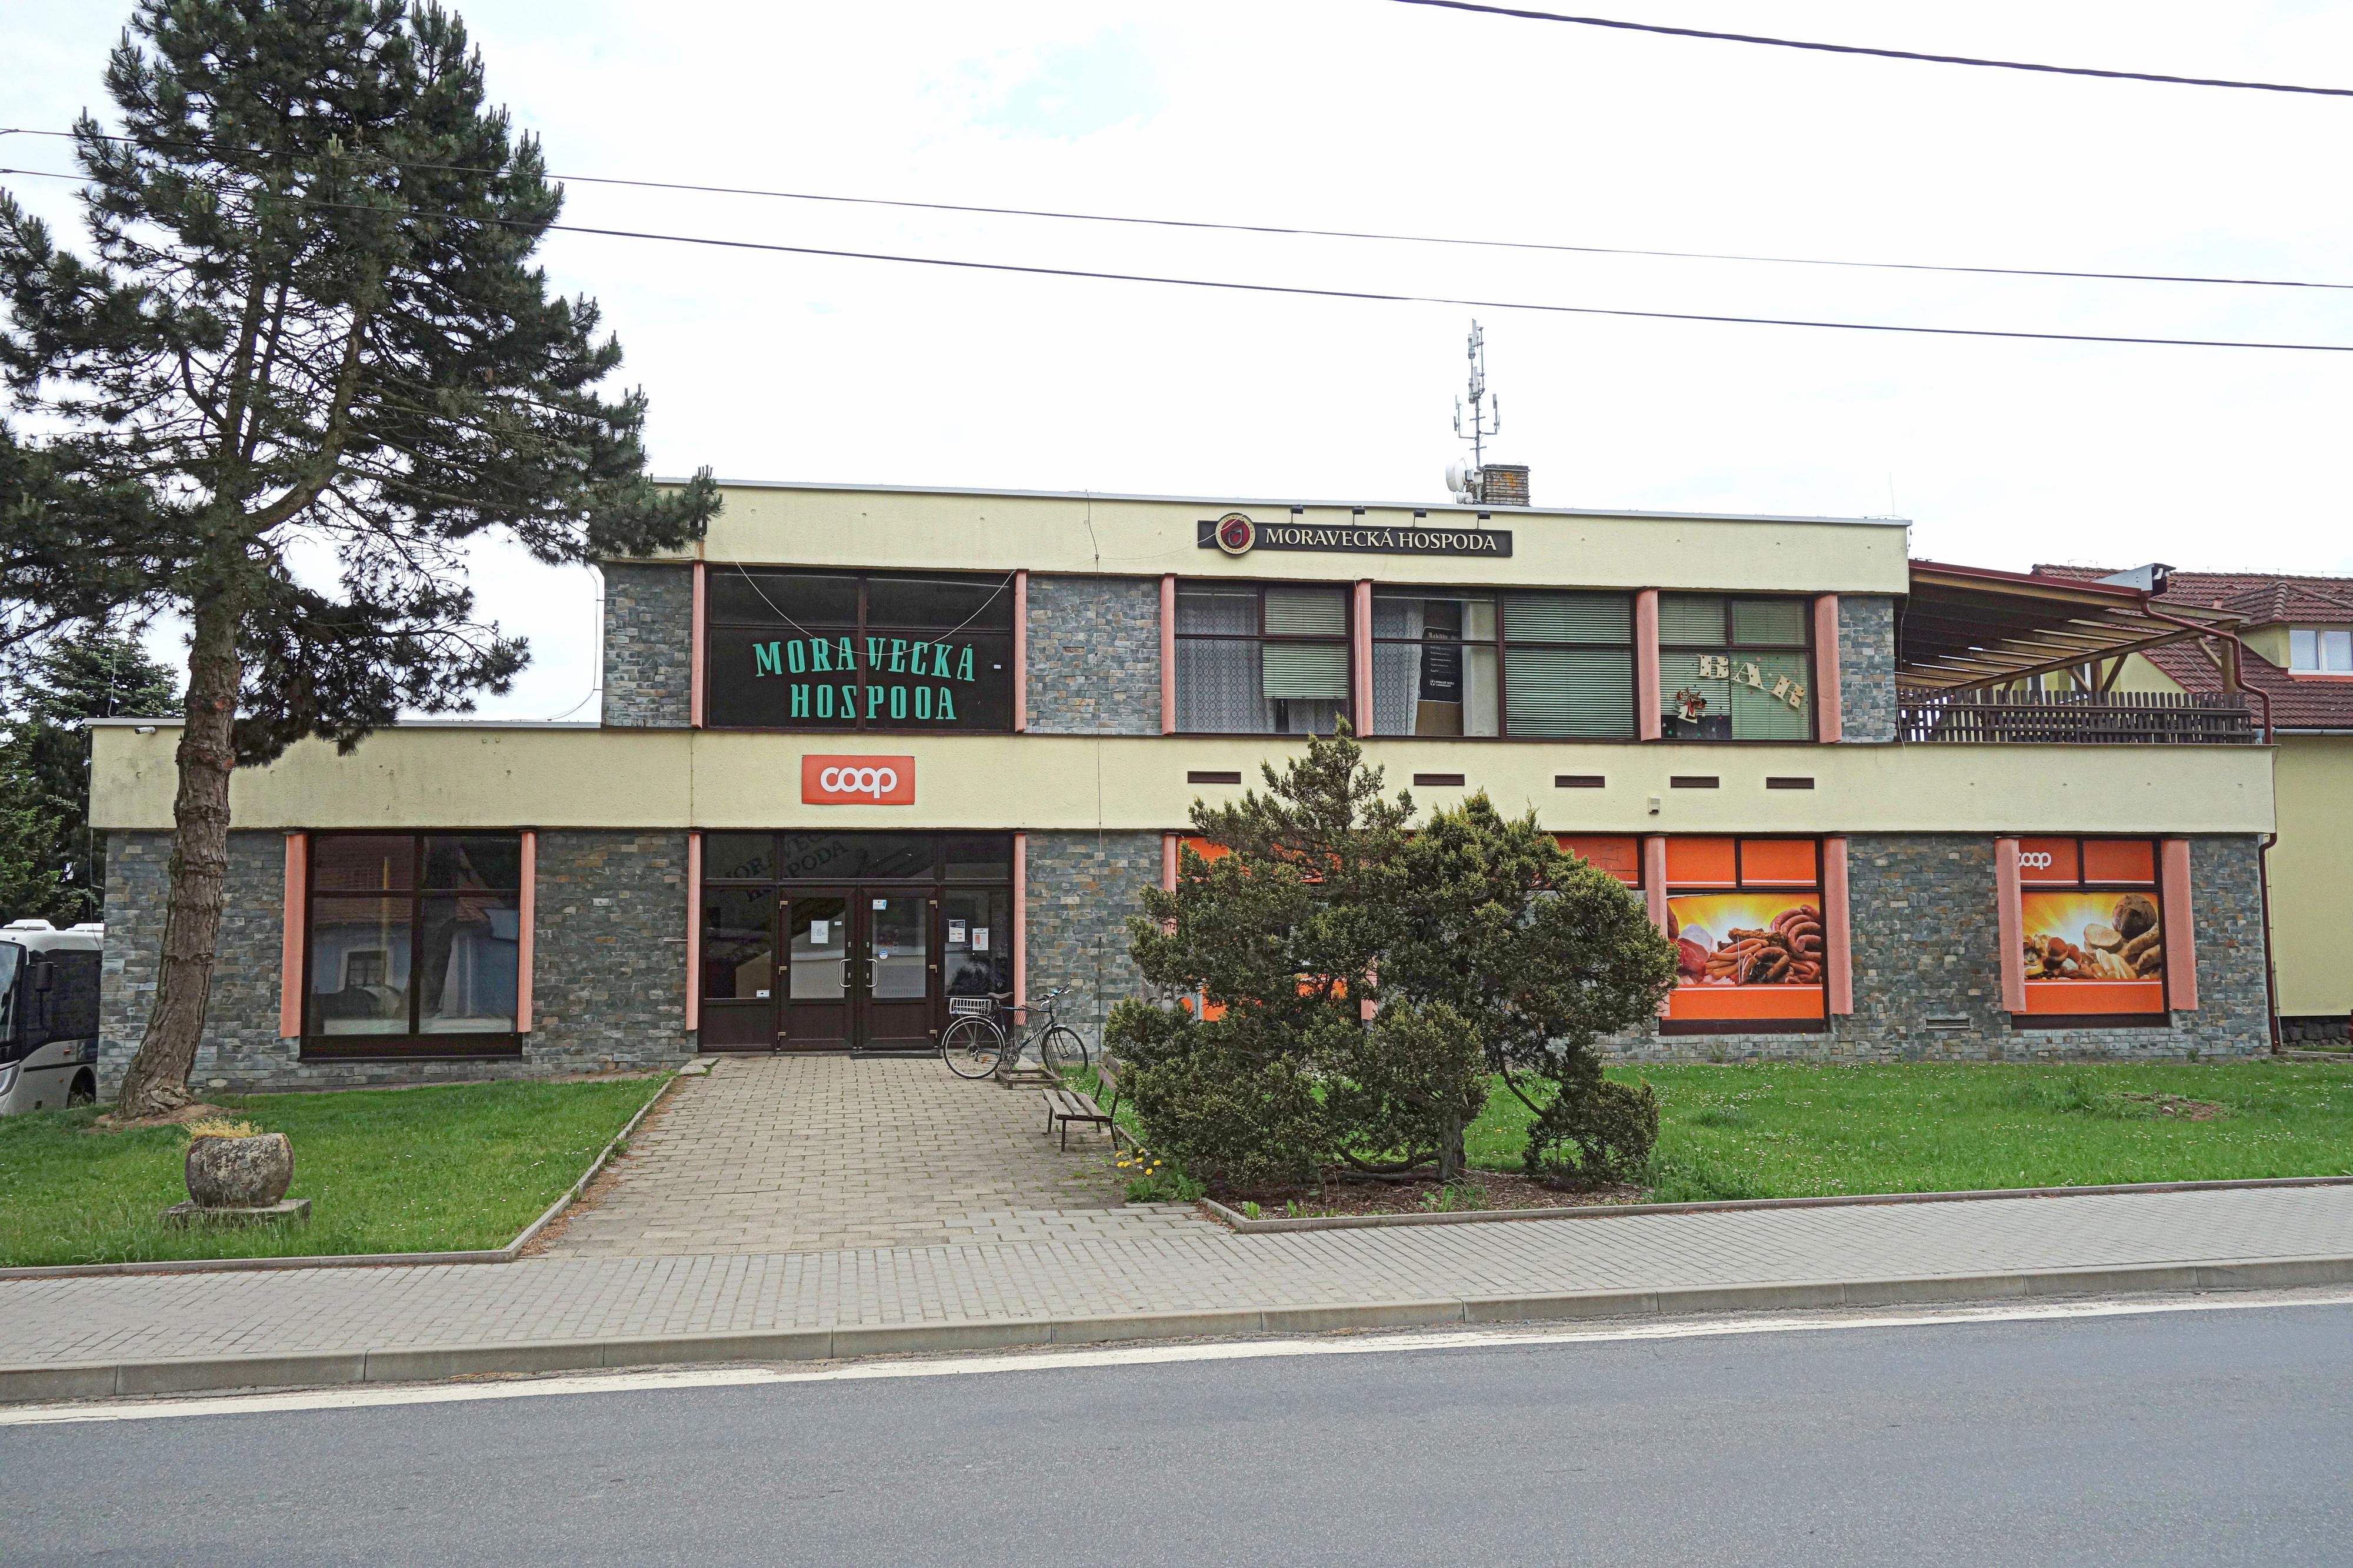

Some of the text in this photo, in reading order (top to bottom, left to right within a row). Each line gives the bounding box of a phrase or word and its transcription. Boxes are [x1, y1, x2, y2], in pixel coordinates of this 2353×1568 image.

[1265, 528, 1394, 548] MORAVECKÁ
[1398, 532, 1497, 551] HOSPODA
[752, 636, 975, 682] MORAVECKÁ
[1696, 653, 1805, 709] BAR
[790, 683, 957, 720] HOSPODA
[819, 766, 898, 799] coop
[2019, 852, 2052, 870] oop
